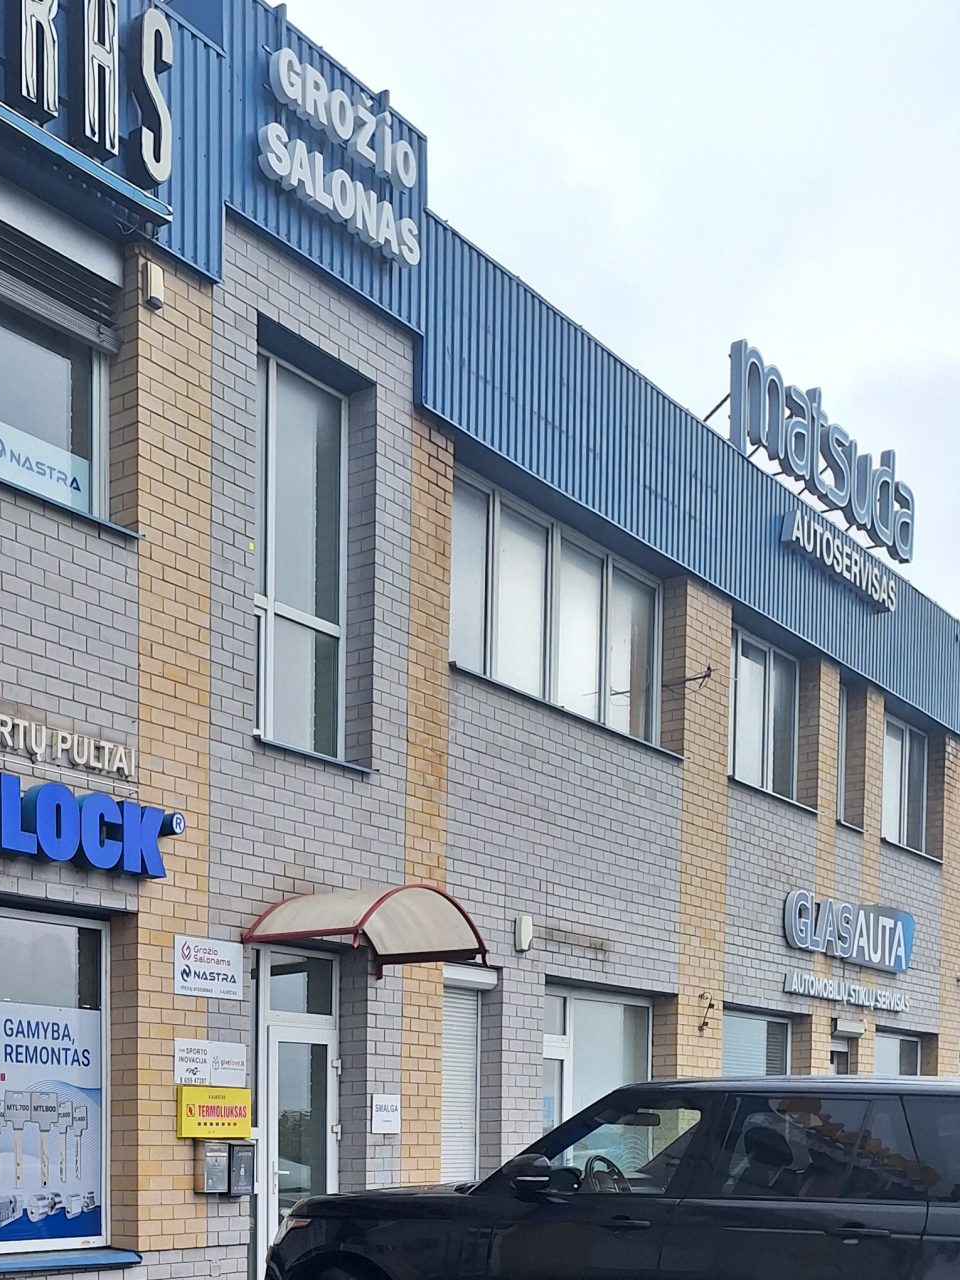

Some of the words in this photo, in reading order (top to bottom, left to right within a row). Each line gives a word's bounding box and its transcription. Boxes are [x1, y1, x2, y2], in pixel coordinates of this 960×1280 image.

[259, 122, 421, 267] SALONAS
[730, 339, 915, 563] matsuda
[9, 450, 82, 493] NASTRA
[788, 509, 897, 612] AUTOSERVISAS
[52, 730, 136, 777] PULTAI
[788, 889, 907, 971] GLASAUTA
[193, 945, 219, 956] Grožio
[193, 954, 231, 967] Salonams
[193, 969, 237, 984] NASTRA
[791, 971, 848, 1005] AUTOMOBILIŲ
[849, 984, 876, 1010] STIKLŲ
[877, 989, 910, 1013] SERVISAS
[3, 1018, 76, 1046] GAMYBA,
[3, 1043, 91, 1068] REMONTAS
[178, 1055, 208, 1065] INOVACIJA
[185, 1047, 208, 1056] SPORTO
[6, 1104, 30, 1112] MTL700
[197, 1104, 247, 1118] TERMOLIUKSAS
[374, 1103, 399, 1113] SMALGA
